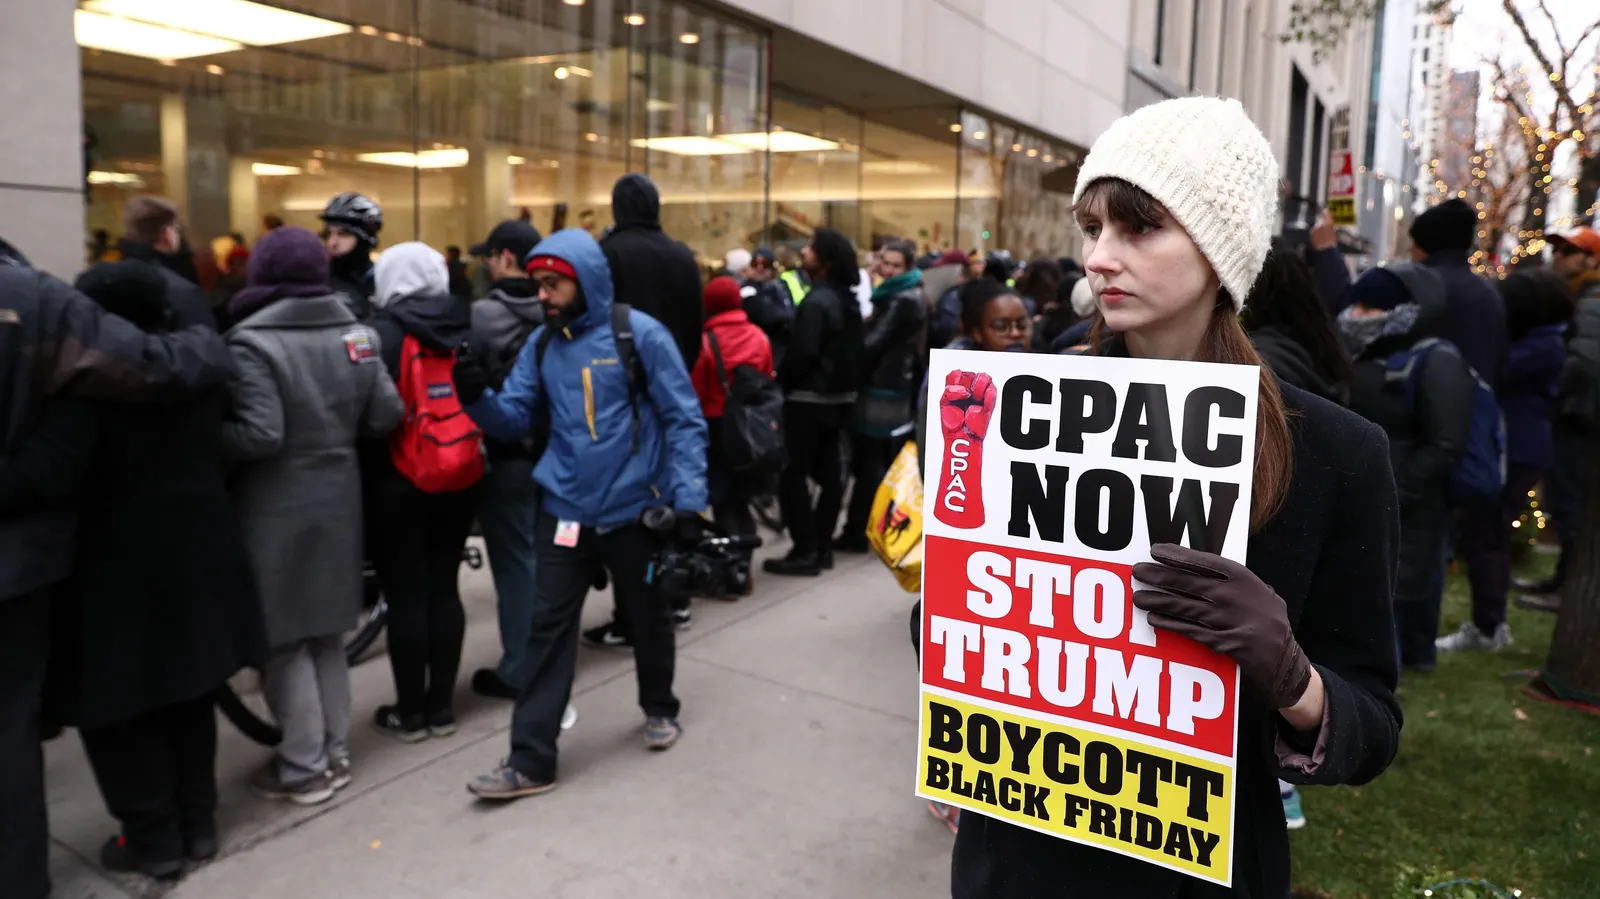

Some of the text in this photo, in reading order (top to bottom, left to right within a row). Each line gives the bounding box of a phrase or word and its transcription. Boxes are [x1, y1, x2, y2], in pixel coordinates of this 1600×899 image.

[1000, 374, 1246, 468] CPAC
[944, 438, 970, 513] CPAC
[1007, 460, 1240, 556] NOW
[930, 614, 1226, 736] TRUMP
[925, 755, 1220, 868] BLACK FRIDAY
[928, 701, 1224, 822] BOYCOTT
